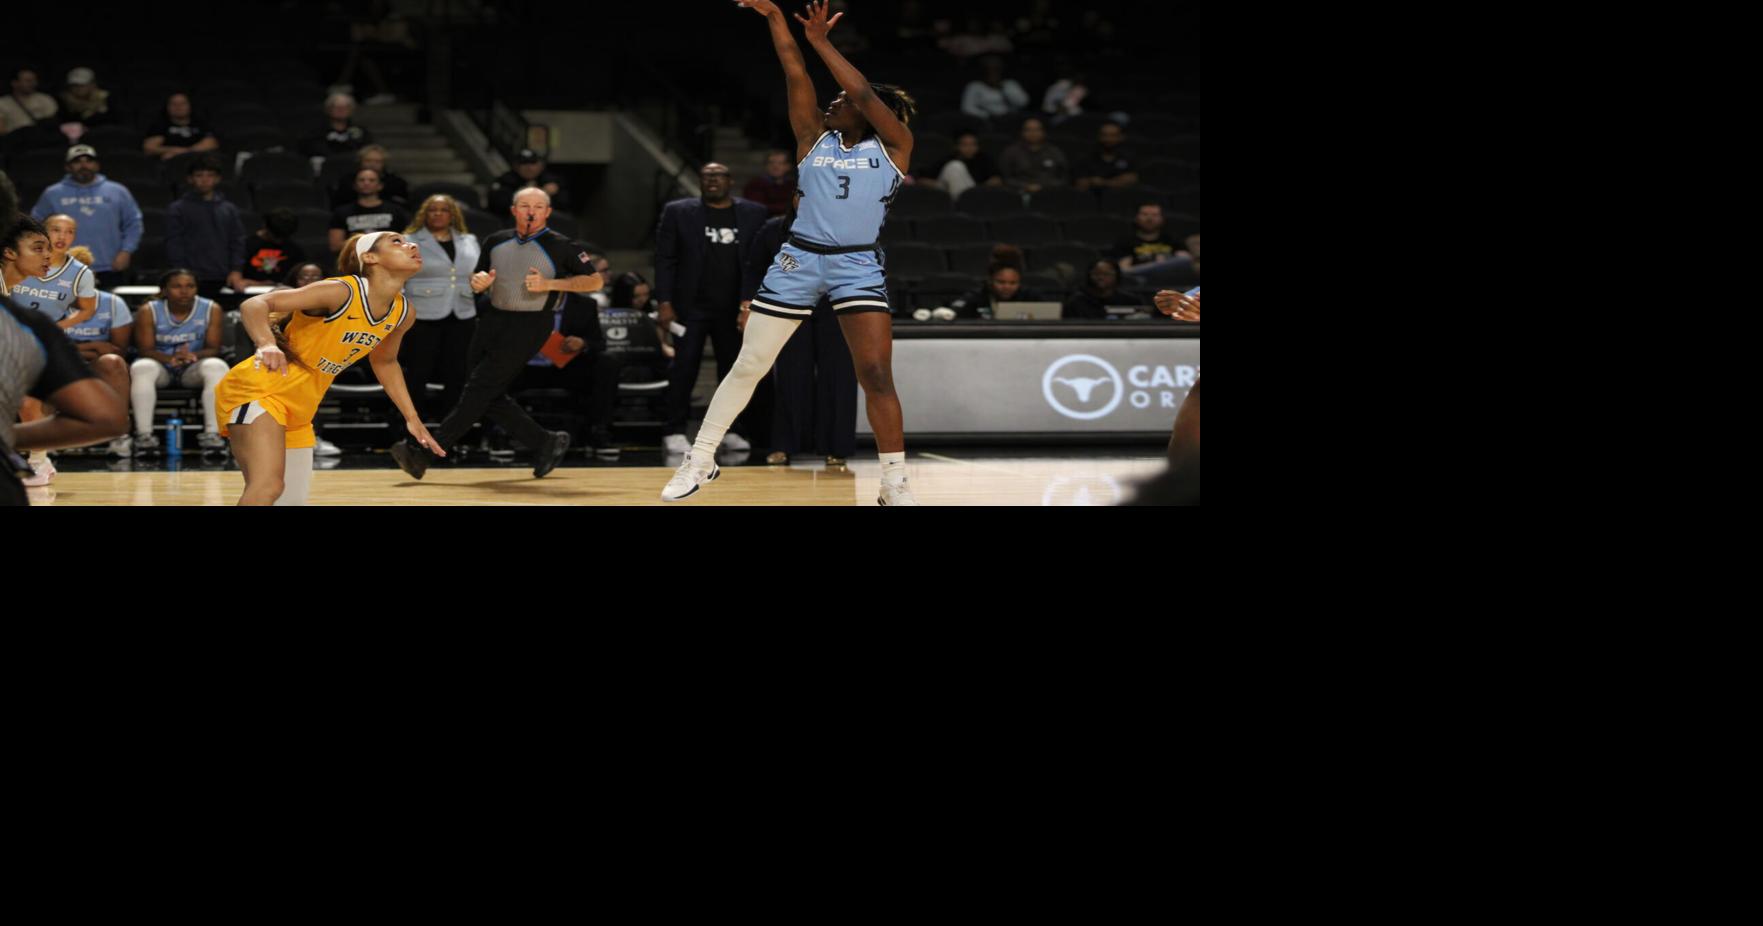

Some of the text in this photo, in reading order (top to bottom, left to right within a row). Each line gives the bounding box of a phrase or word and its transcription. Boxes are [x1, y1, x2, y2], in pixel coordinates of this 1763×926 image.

[812, 156, 880, 169] SPACEU
[836, 175, 850, 199] 3
[13, 284, 67, 301] SPACEU
[341, 330, 381, 349] WEST
[316, 356, 345, 376] VIRG
[1128, 365, 1200, 388] CAR
[1129, 390, 1189, 409] OR
